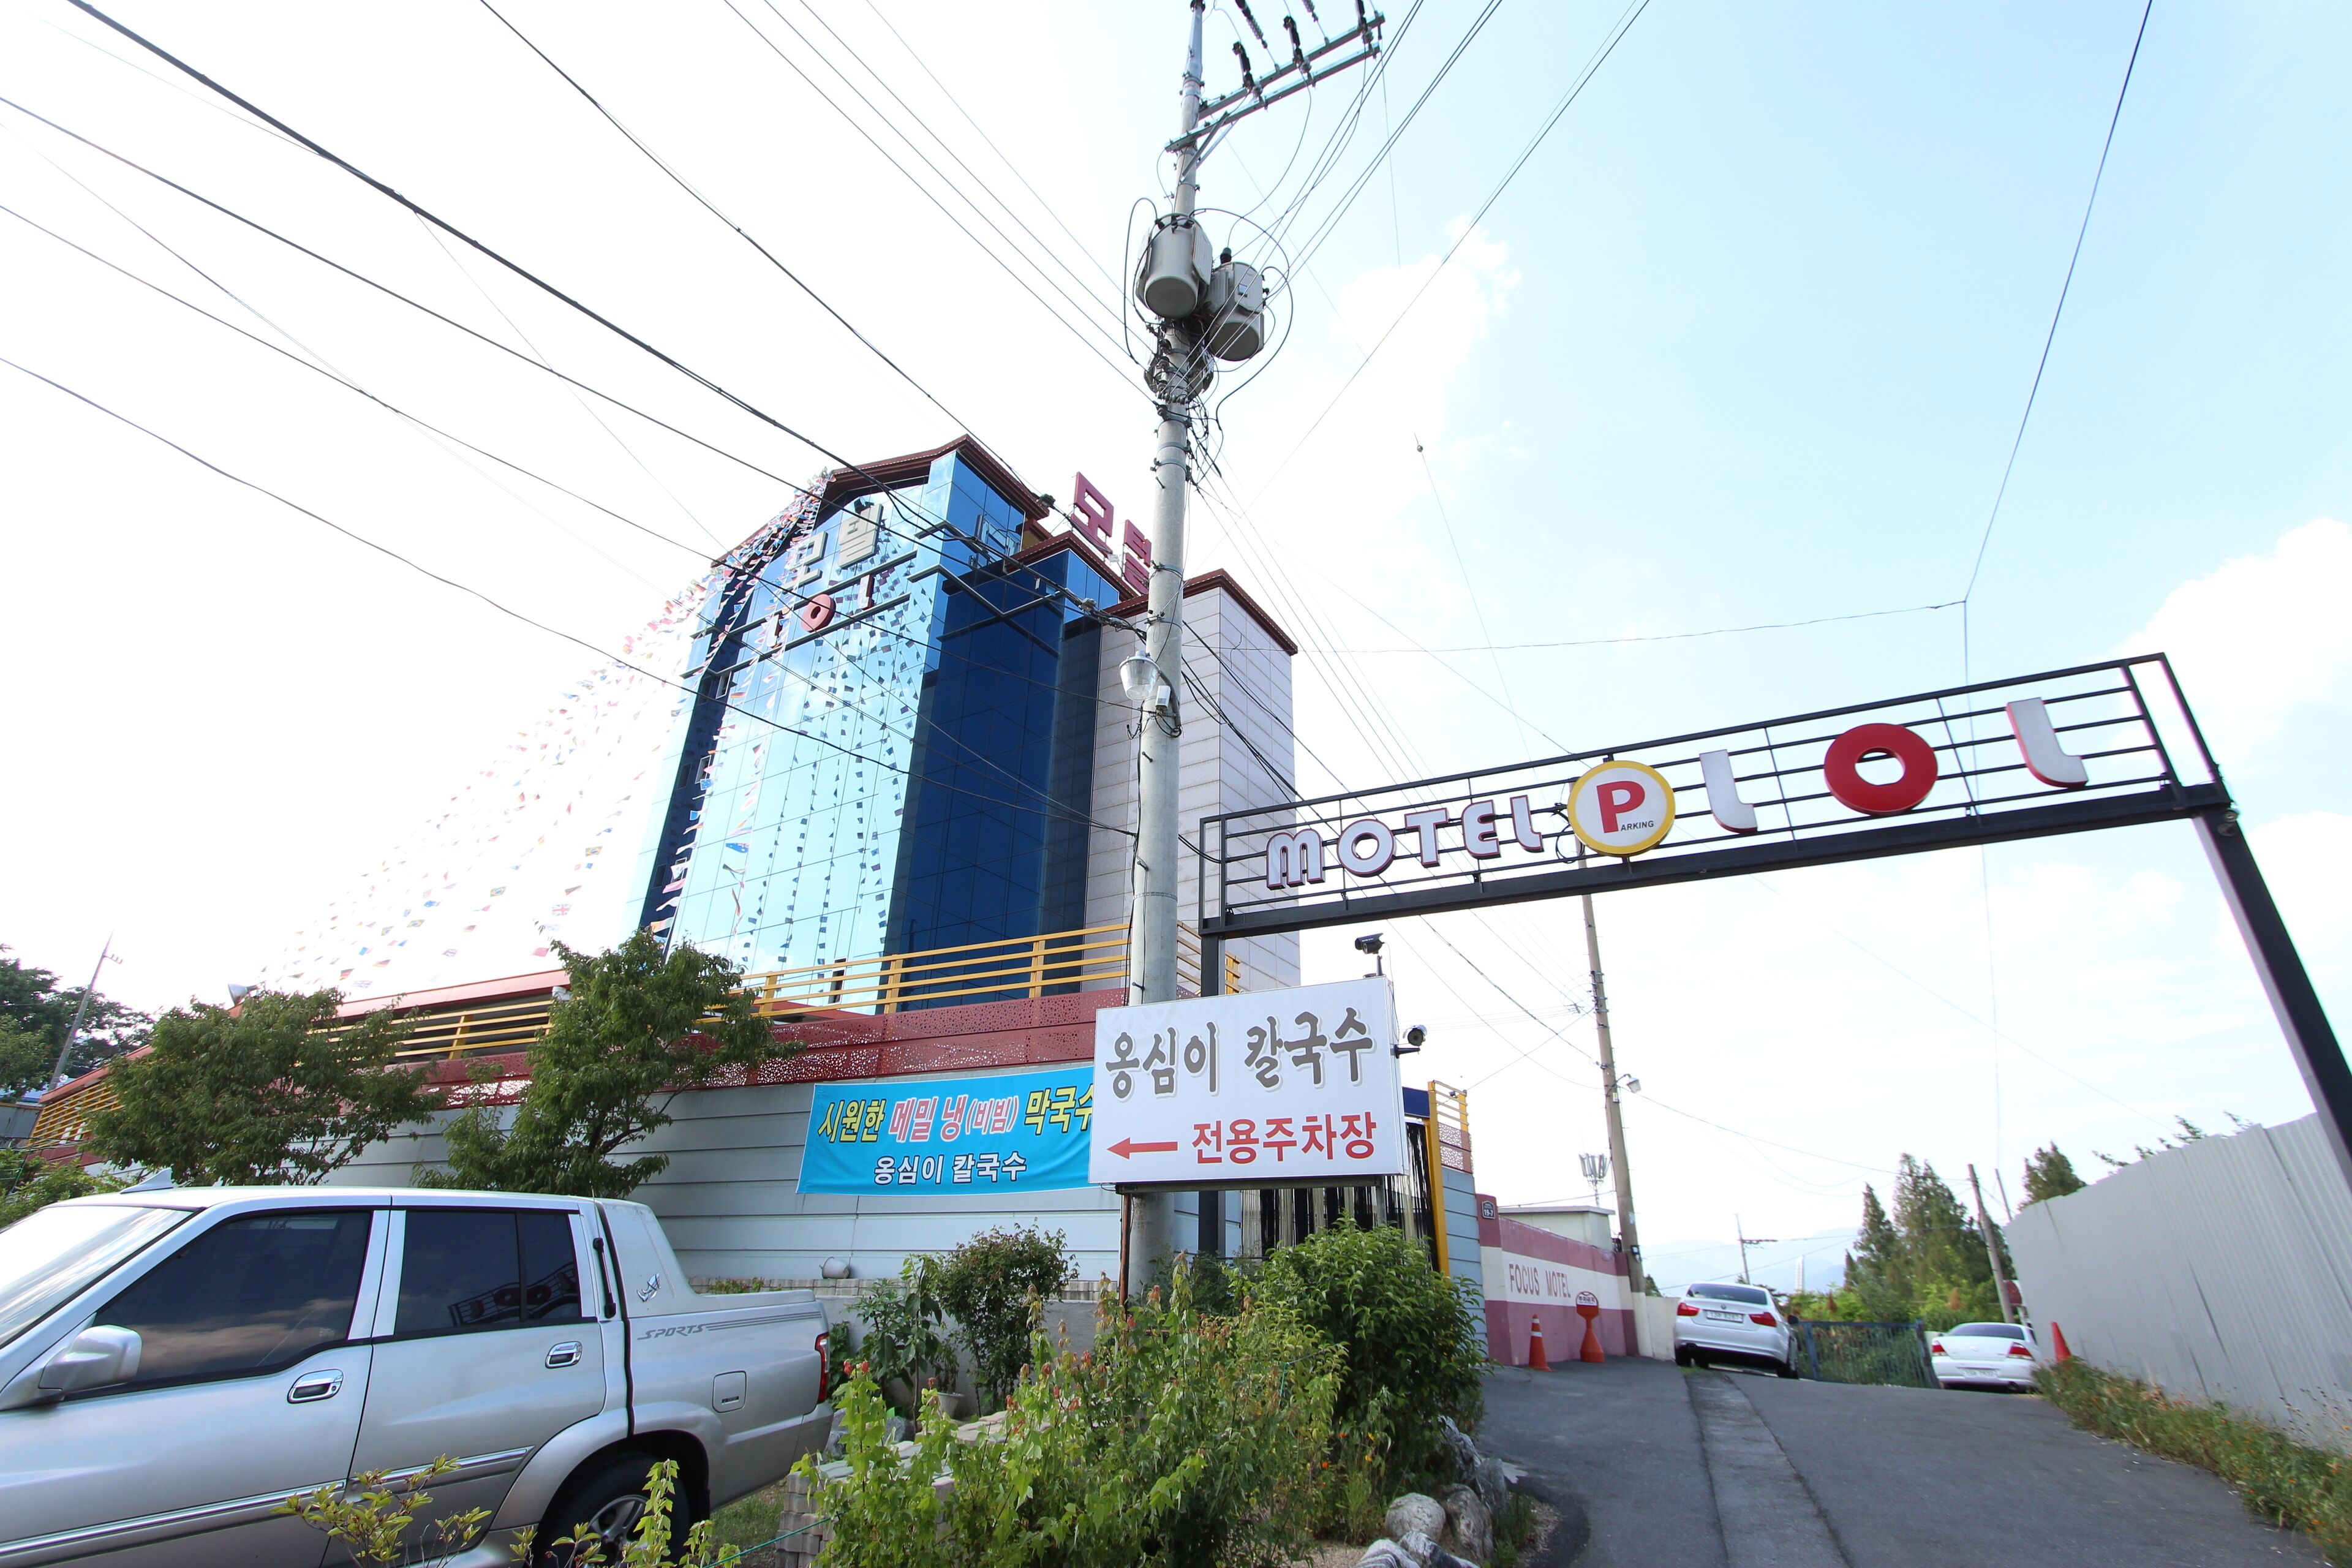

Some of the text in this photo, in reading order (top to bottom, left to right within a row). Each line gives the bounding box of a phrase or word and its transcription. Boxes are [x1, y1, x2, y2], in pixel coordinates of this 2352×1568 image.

[1266, 794, 1544, 890] MOTEL
[1105, 1007, 1373, 1099] 옹심이 칼국수
[818, 1099, 886, 1143] 시원한
[888, 1096, 937, 1144] 메밀
[1192, 1111, 1377, 1164] 전용주차장
[873, 1151, 1027, 1185] 옹심이 칼국수
[1508, 1263, 1572, 1298] FOCUS MOTEL
[636, 1324, 704, 1341] SPORTS
